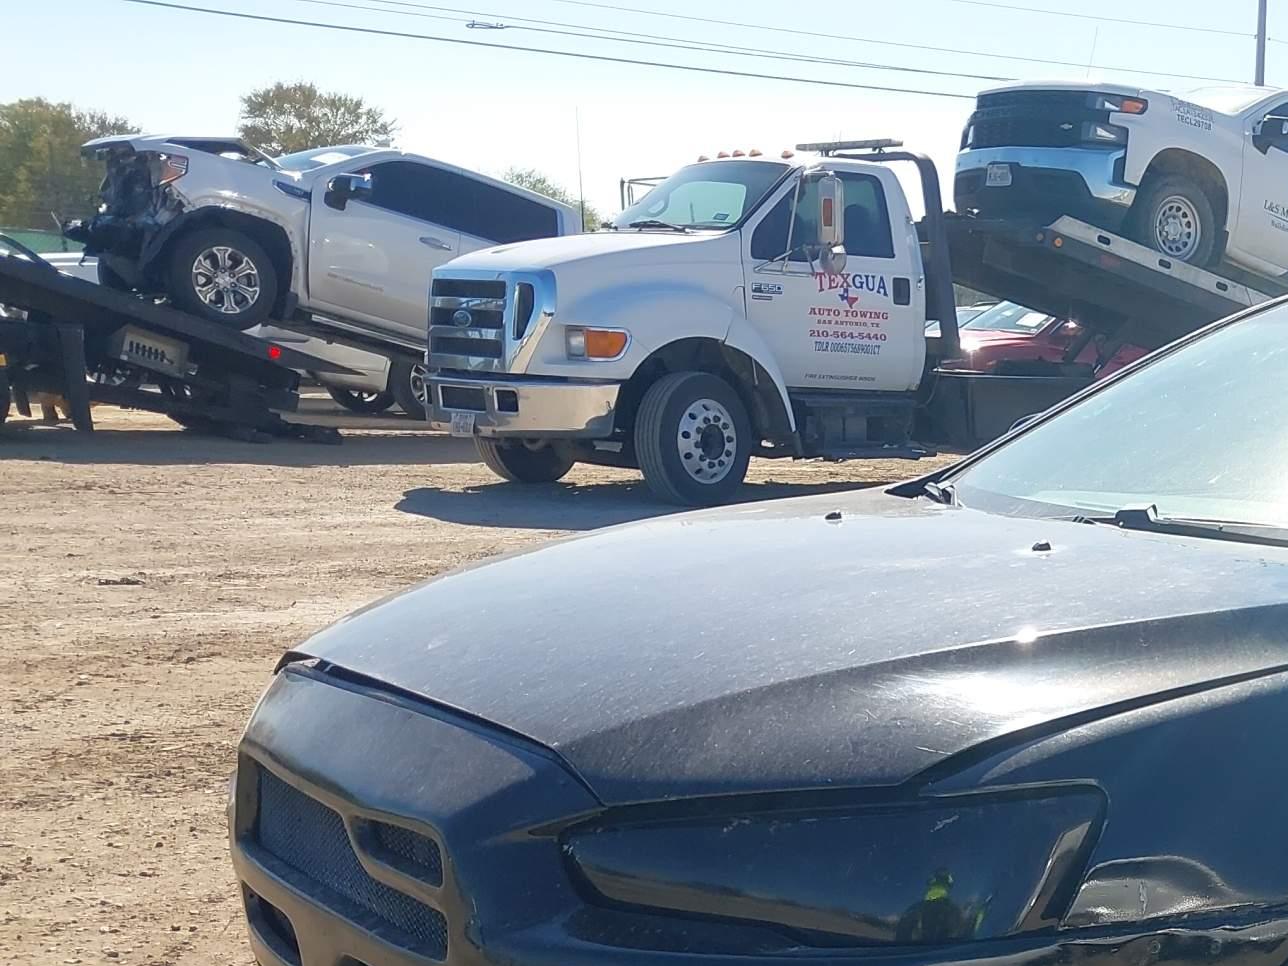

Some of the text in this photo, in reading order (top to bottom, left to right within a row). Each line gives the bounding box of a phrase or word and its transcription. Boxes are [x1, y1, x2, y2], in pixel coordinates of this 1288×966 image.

[1263, 199, 1281, 214] L&S
[815, 272, 889, 297] TEXGUA
[808, 307, 889, 321] AUTO TOWING
[809, 329, 887, 342] 210-564-5440
